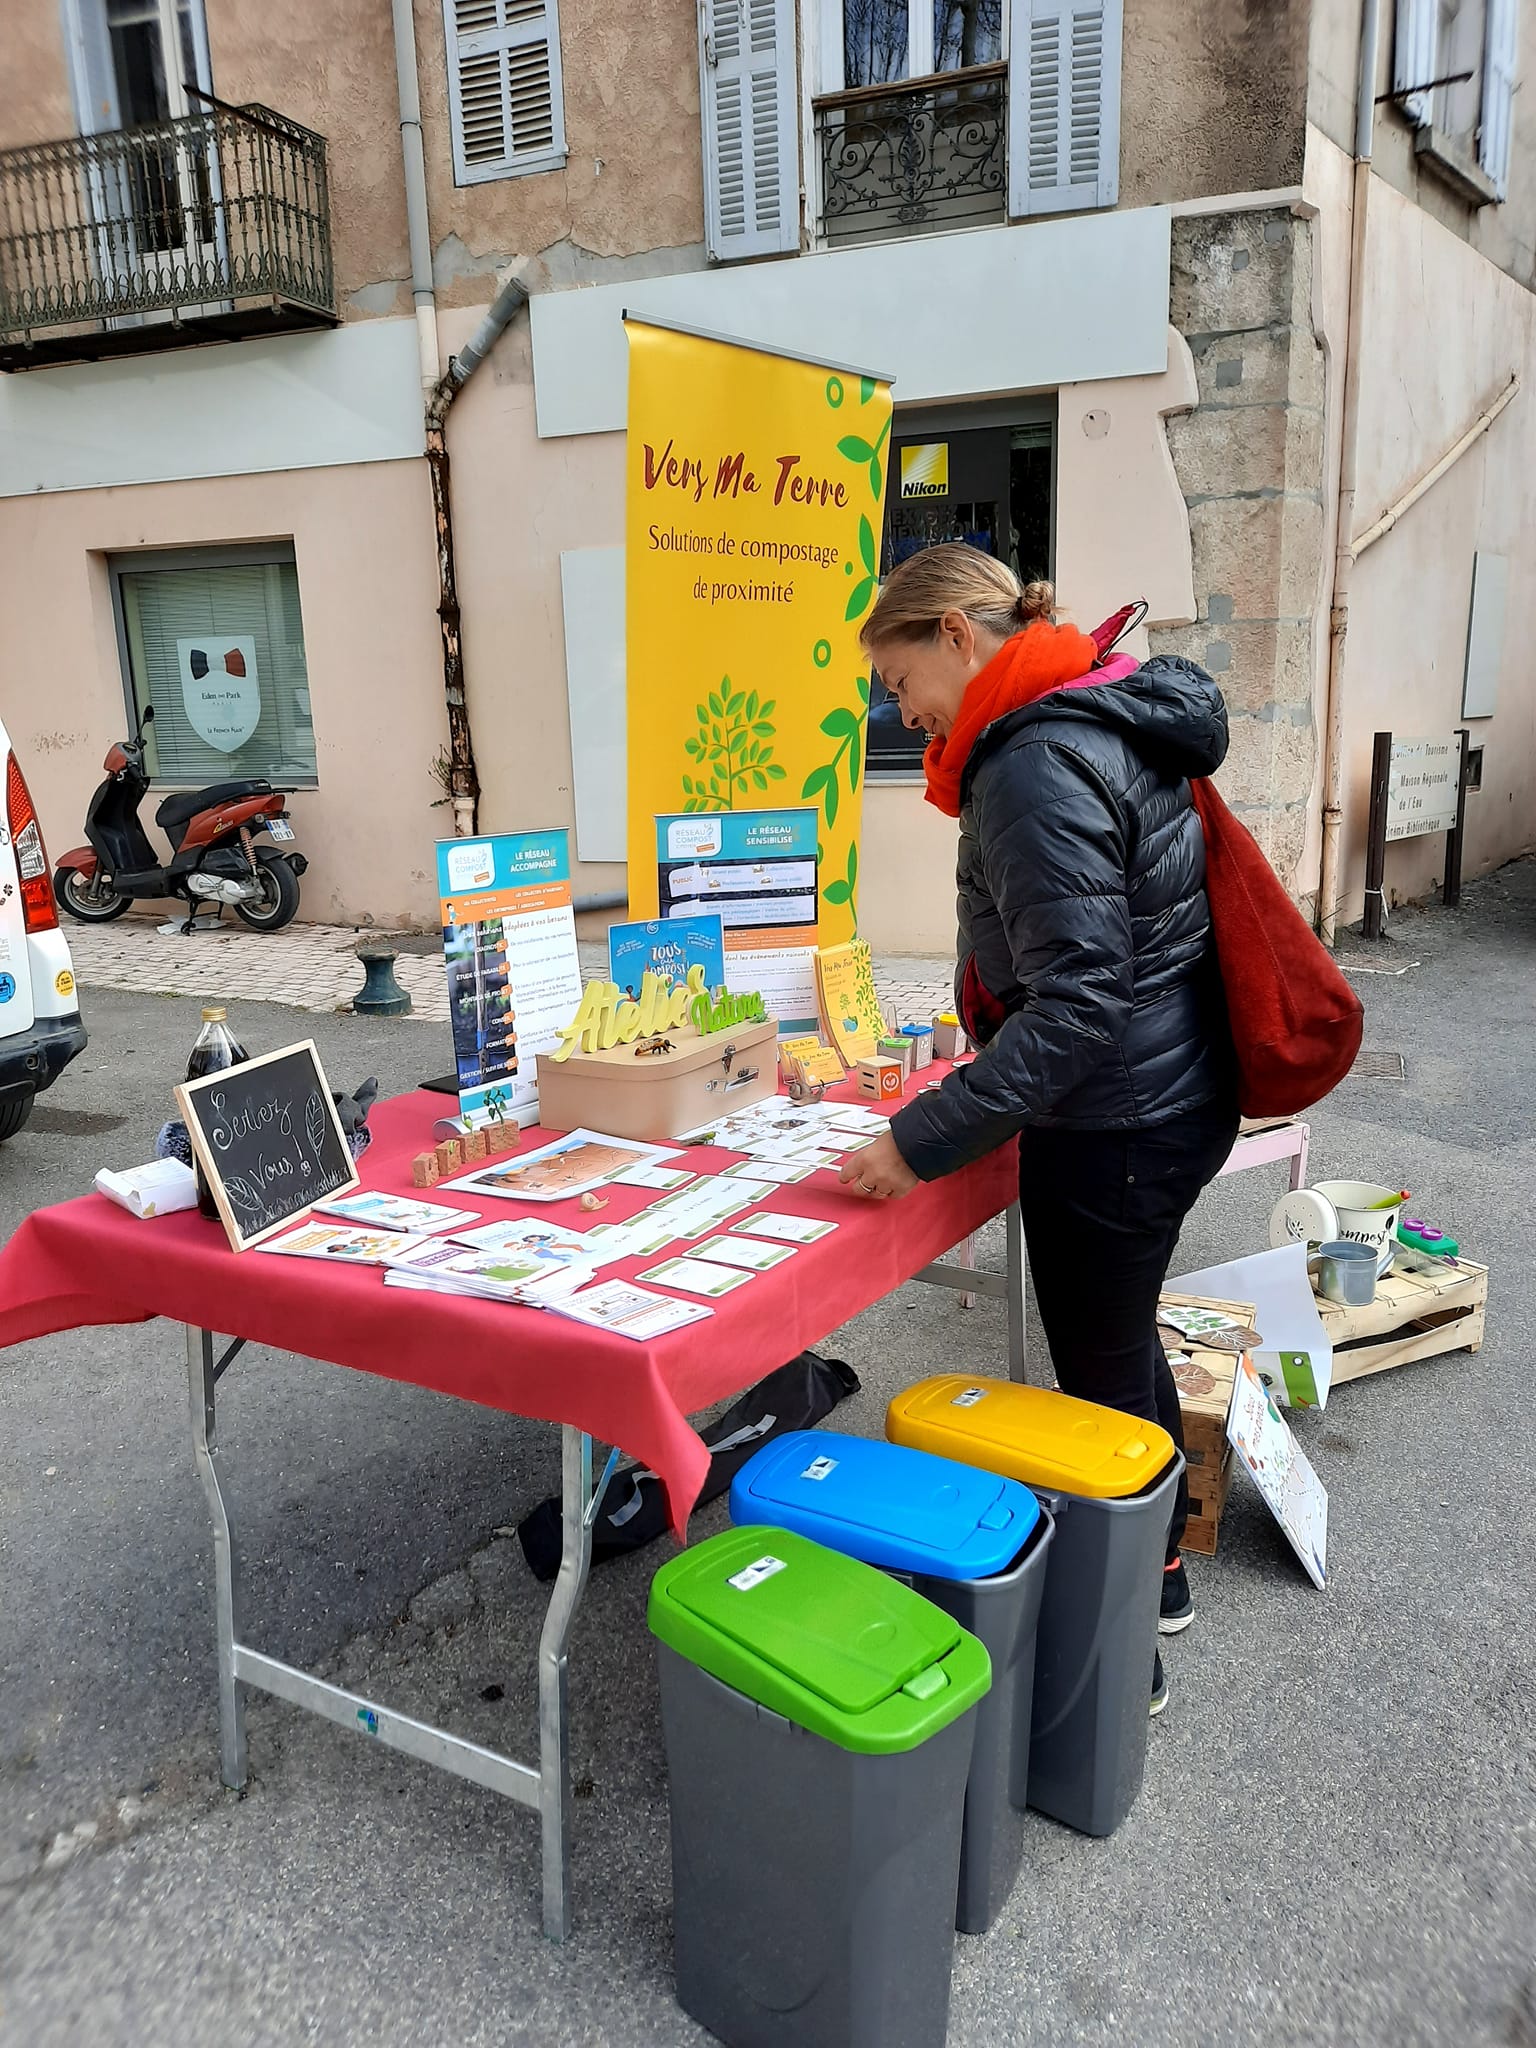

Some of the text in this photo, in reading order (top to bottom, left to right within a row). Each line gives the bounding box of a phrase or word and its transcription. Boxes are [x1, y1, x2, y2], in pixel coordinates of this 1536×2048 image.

[643, 439, 850, 508] Vers Ma Terre
[903, 482, 947, 497] Nikon
[648, 524, 839, 569] Solutions de compostage
[693, 576, 794, 606] de proximité
[201, 691, 241, 700] Eden Park
[1425, 743, 1449, 757] Tourisme
[1400, 770, 1448, 788] Maison Régionale
[1399, 799, 1406, 811] de
[675, 828, 705, 837] RÉSEAU
[759, 825, 792, 835] RÉSEAU
[676, 835, 712, 844] COMPOST
[746, 835, 793, 845] SENSIBILISE
[515, 848, 550, 860] LE RÉSEAU
[510, 859, 557, 873] ACCOMPAGNE
[672, 876, 693, 885] PUBLIC
[651, 942, 682, 961] TOUS
[486, 1037, 514, 1049] FORMATION
[460, 1069, 482, 1080] GESTION
[249, 1152, 294, 1190] Vous
